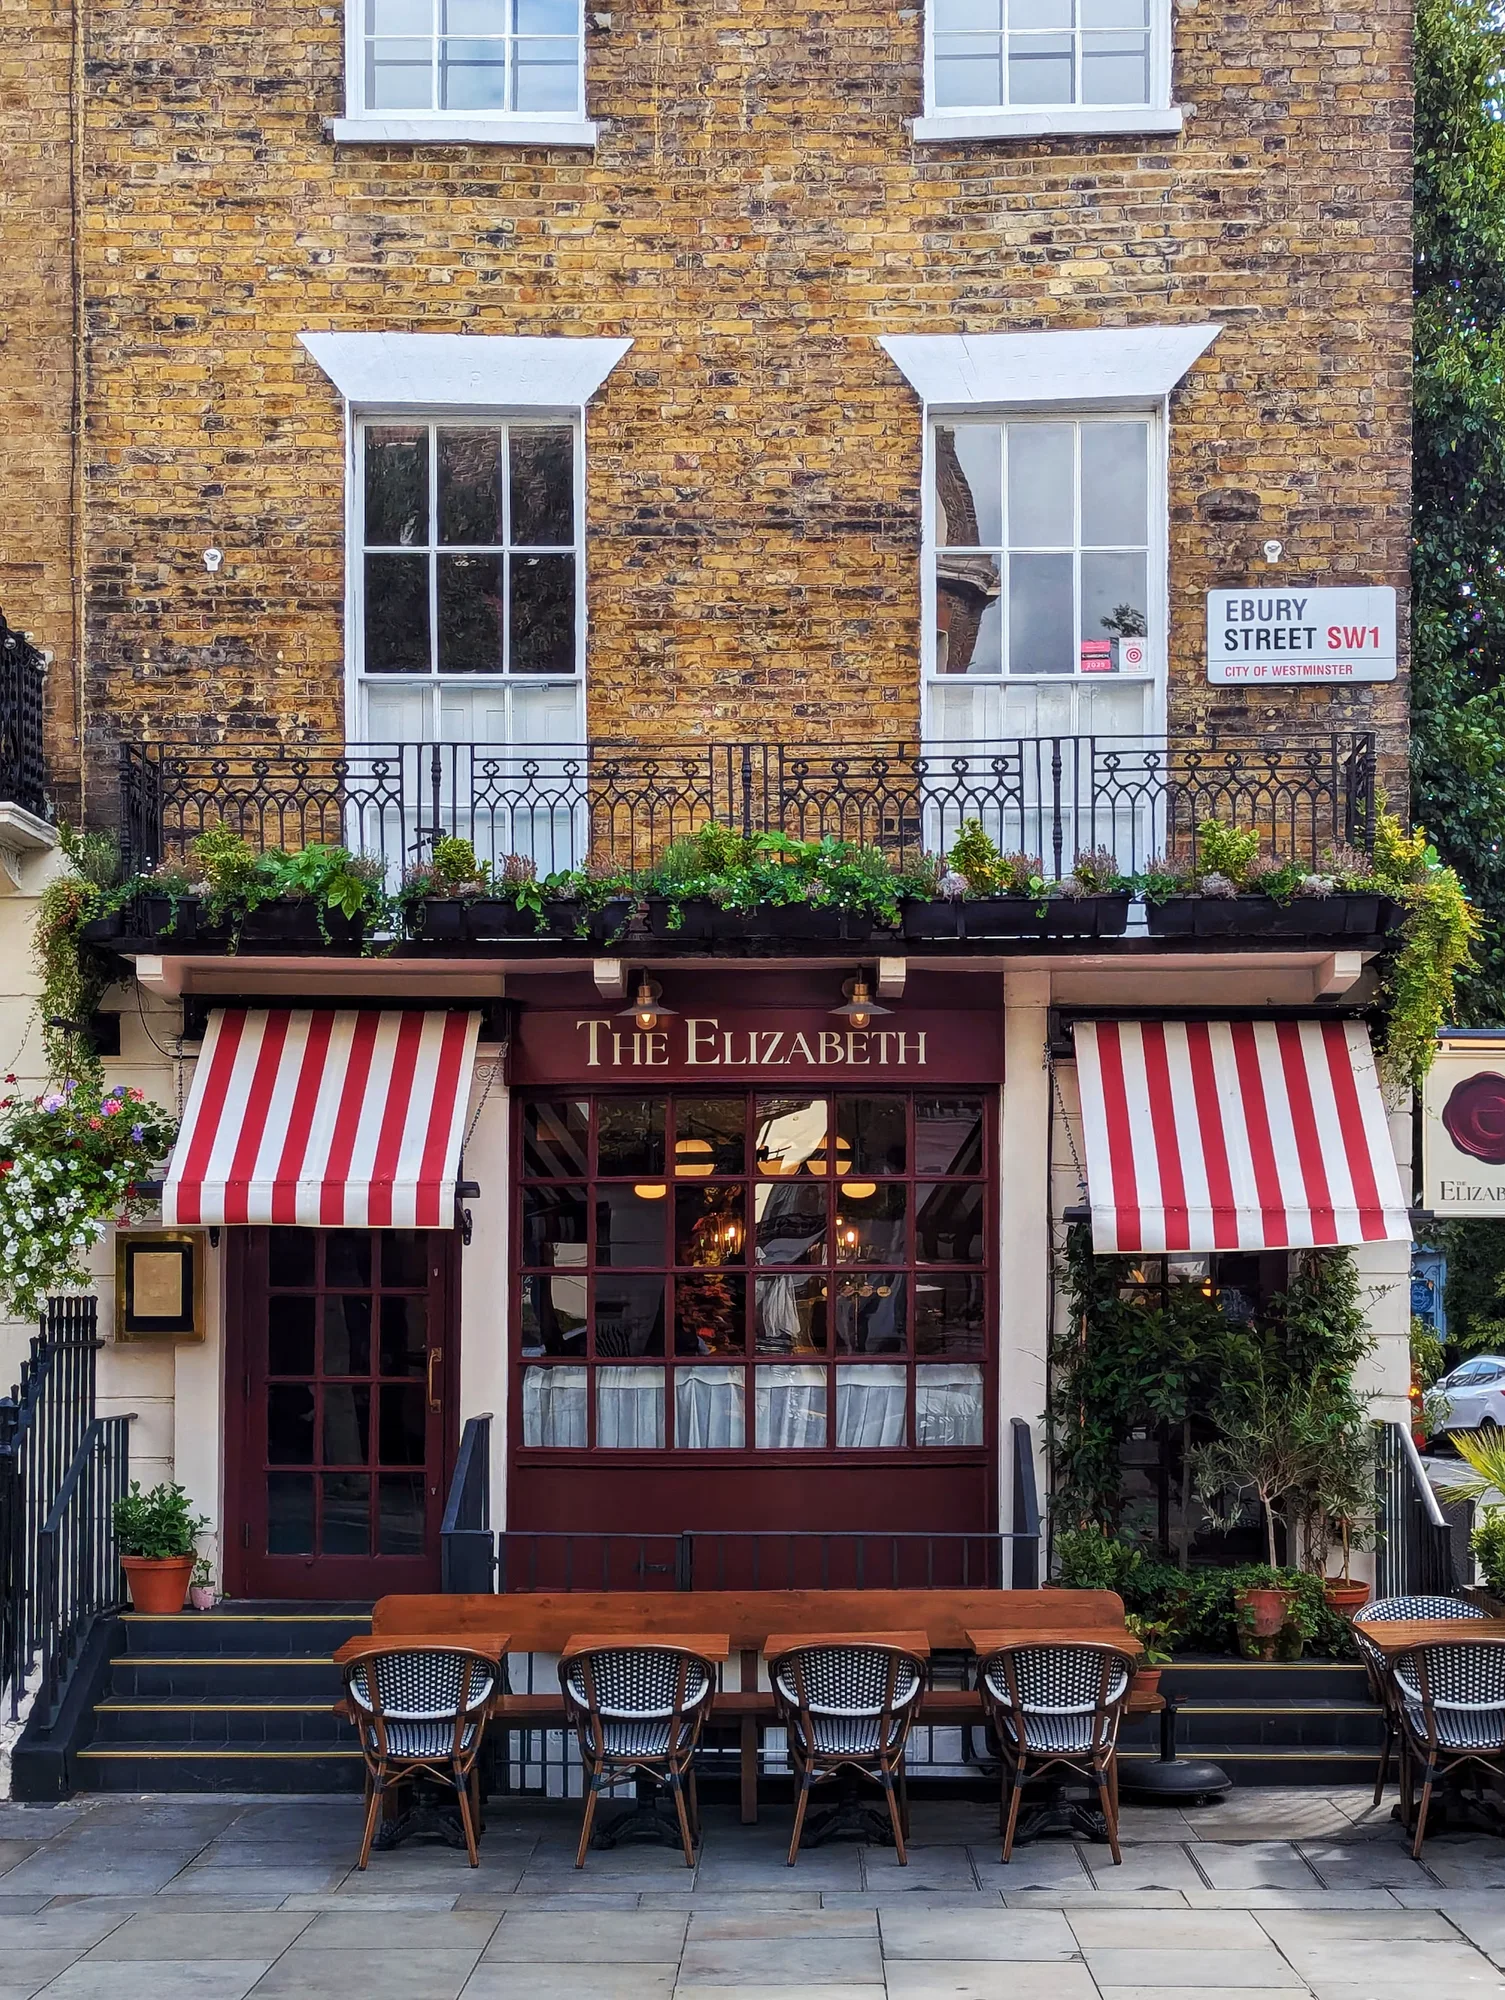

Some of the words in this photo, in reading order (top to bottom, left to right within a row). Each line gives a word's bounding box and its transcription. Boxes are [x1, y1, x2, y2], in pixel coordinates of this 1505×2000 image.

[1226, 598, 1308, 622] EBURY
[1224, 627, 1317, 651] STREET
[1327, 626, 1379, 649] SW1
[1225, 666, 1250, 677] CITY
[1254, 666, 1268, 677] OF
[1272, 664, 1353, 677] WESTMINSTER
[576, 1018, 670, 1066] THE
[684, 1018, 927, 1065] ELIZABETH
